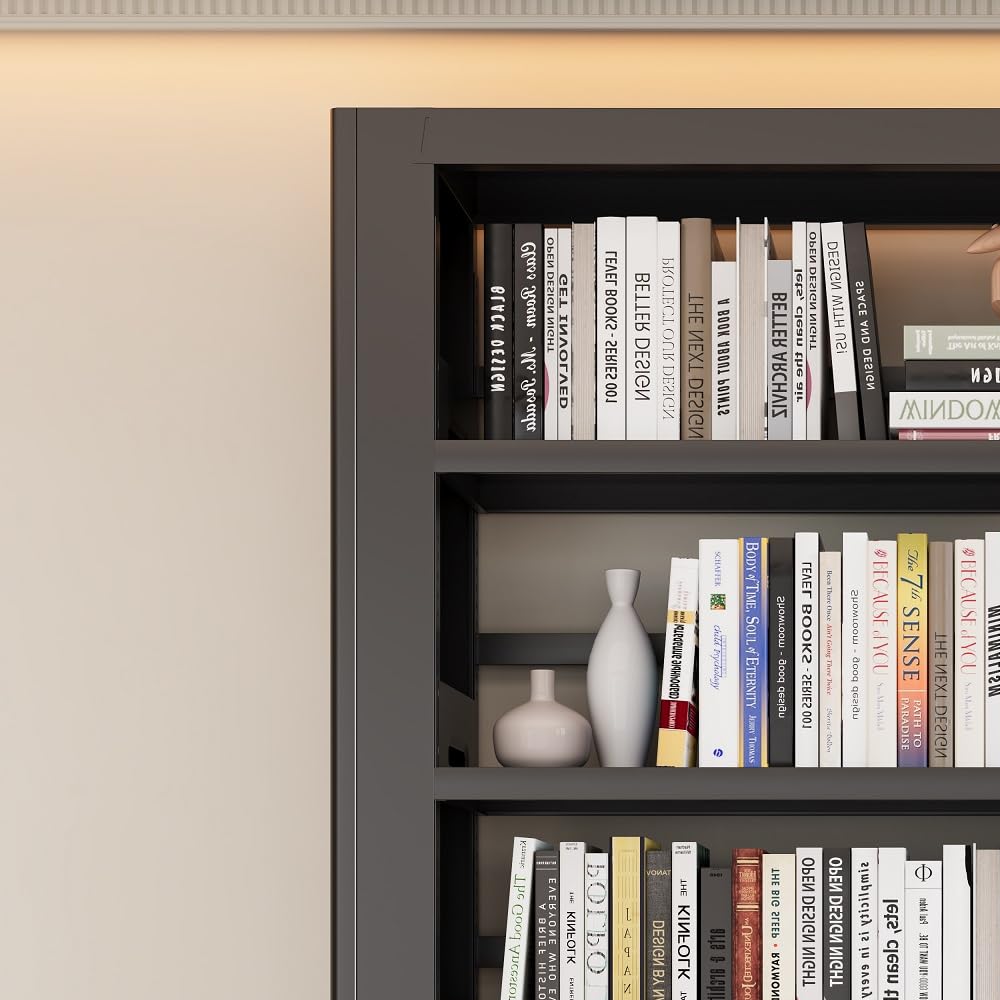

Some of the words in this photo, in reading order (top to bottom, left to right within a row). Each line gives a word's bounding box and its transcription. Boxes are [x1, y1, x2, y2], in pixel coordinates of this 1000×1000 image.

[746, 542, 759, 572] BODY
[907, 550, 918, 571] The
[745, 581, 759, 612] TIME,
[900, 575, 923, 601] 7th
[746, 617, 759, 645] SOUL
[903, 607, 920, 680] SENSE
[746, 647, 759, 656] of
[746, 657, 759, 708] ETERNITY
[902, 698, 910, 750] PARADISE
[914, 700, 922, 728] PATH
[749, 737, 757, 763] THOMAS
[914, 732, 922, 748] TO
